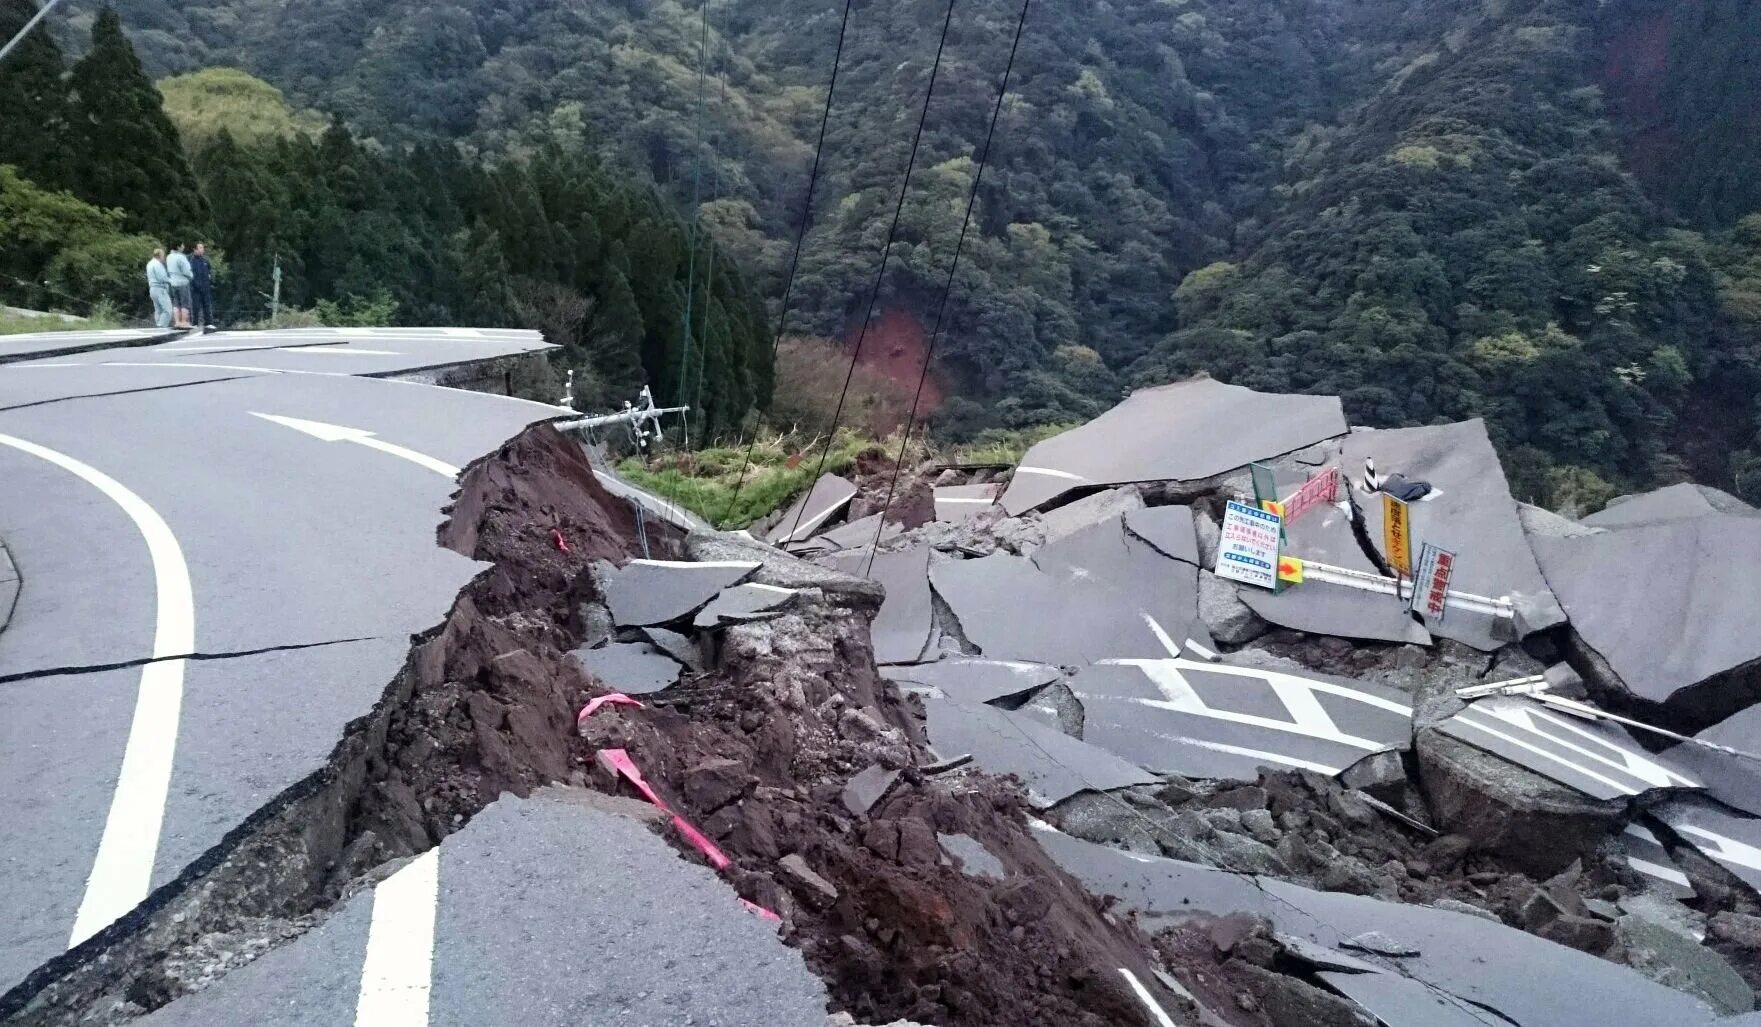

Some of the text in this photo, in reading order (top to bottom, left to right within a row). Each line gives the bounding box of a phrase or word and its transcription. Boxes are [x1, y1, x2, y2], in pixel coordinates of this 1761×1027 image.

[1428, 553, 1452, 613] 重点警戒中
